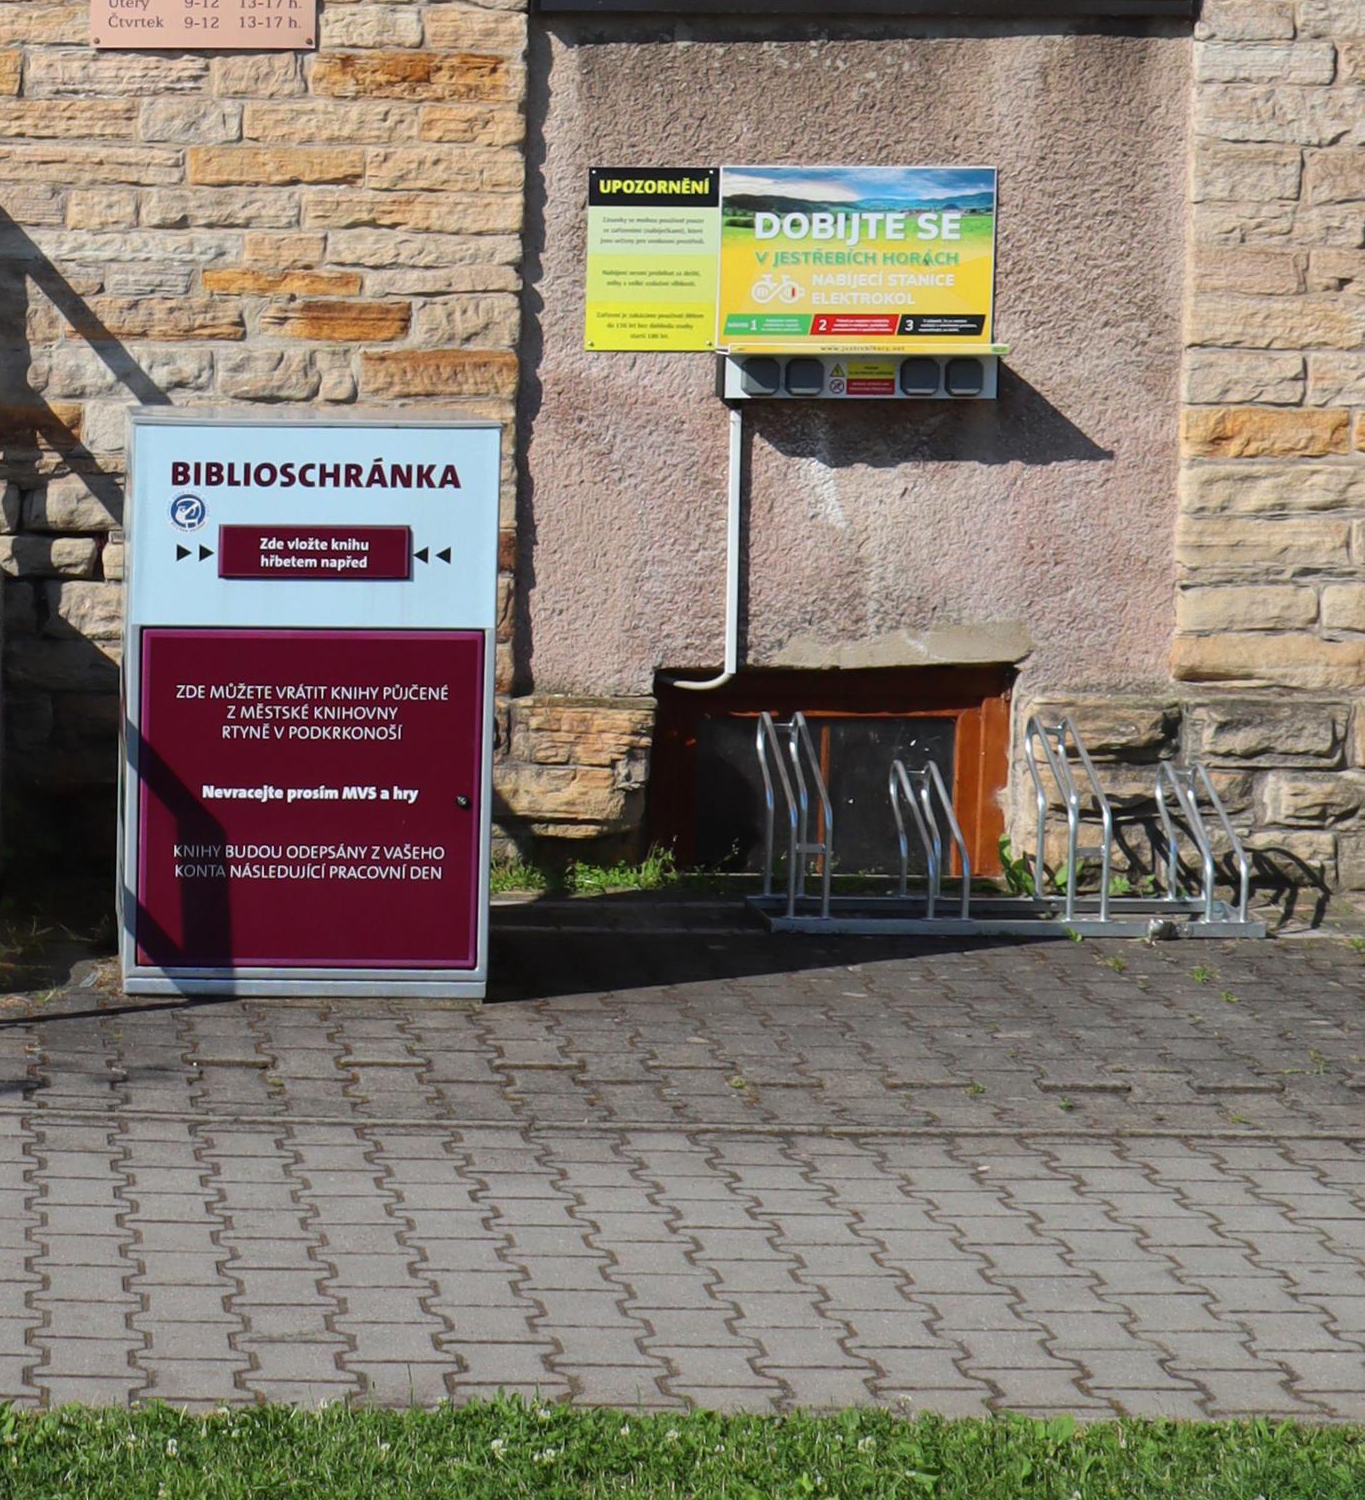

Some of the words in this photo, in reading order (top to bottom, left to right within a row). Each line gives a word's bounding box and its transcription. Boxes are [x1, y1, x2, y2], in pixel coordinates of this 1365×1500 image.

[108, 14, 164, 28] Čtvrtek
[184, 17, 220, 29] 9-12
[239, 17, 283, 29] 13-17
[289, 17, 302, 29] h.
[599, 177, 710, 195] UPOZORNĚNÍ
[755, 212, 905, 246] DOBIJTE
[917, 212, 962, 240] SE
[755, 252, 768, 265] V
[773, 248, 876, 267] JESTŘEBÍCH
[883, 249, 959, 265] HORÁCH
[888, 274, 955, 286] STANICE
[812, 292, 915, 305] ELEKTROKOL
[750, 320, 757, 331] 1
[819, 320, 827, 331] 2
[905, 320, 914, 331] 3
[171, 458, 462, 489] BIBLIOSCHRÁNKA
[260, 538, 284, 549] Zde
[287, 538, 327, 550] vložte
[331, 538, 369, 550] knihu
[261, 555, 317, 567] hřbetem
[321, 556, 368, 571] napřed
[176, 685, 205, 699] ZDE
[210, 682, 272, 699] MŮŽETE
[276, 684, 327, 699] VRÁTIT
[331, 687, 379, 700] KNIHY
[384, 684, 449, 700] PŮJČENÉ
[227, 706, 236, 719] Z
[240, 703, 308, 719] MĚSTSKÉ
[315, 707, 398, 720] KNIHOVNY
[222, 723, 270, 739] RTYNĚ
[274, 726, 284, 739] V
[289, 724, 402, 740] PODKRKONOŠÍ
[202, 785, 283, 802] Nevracejte
[287, 785, 338, 803] prosím
[342, 787, 377, 799] MVS
[380, 790, 389, 799] a
[393, 786, 418, 803] hry
[174, 845, 221, 858] KNIHY
[226, 846, 282, 858] BUDOU
[286, 843, 367, 859] ODEPSÁNY
[371, 847, 380, 859] Z
[384, 844, 445, 860] VAŠEHO
[175, 865, 226, 877] KONTA
[230, 863, 325, 879] NÁSLEDUJÍCÍ
[330, 864, 407, 879] PRACOVNÍ
[410, 867, 442, 879] DEN
